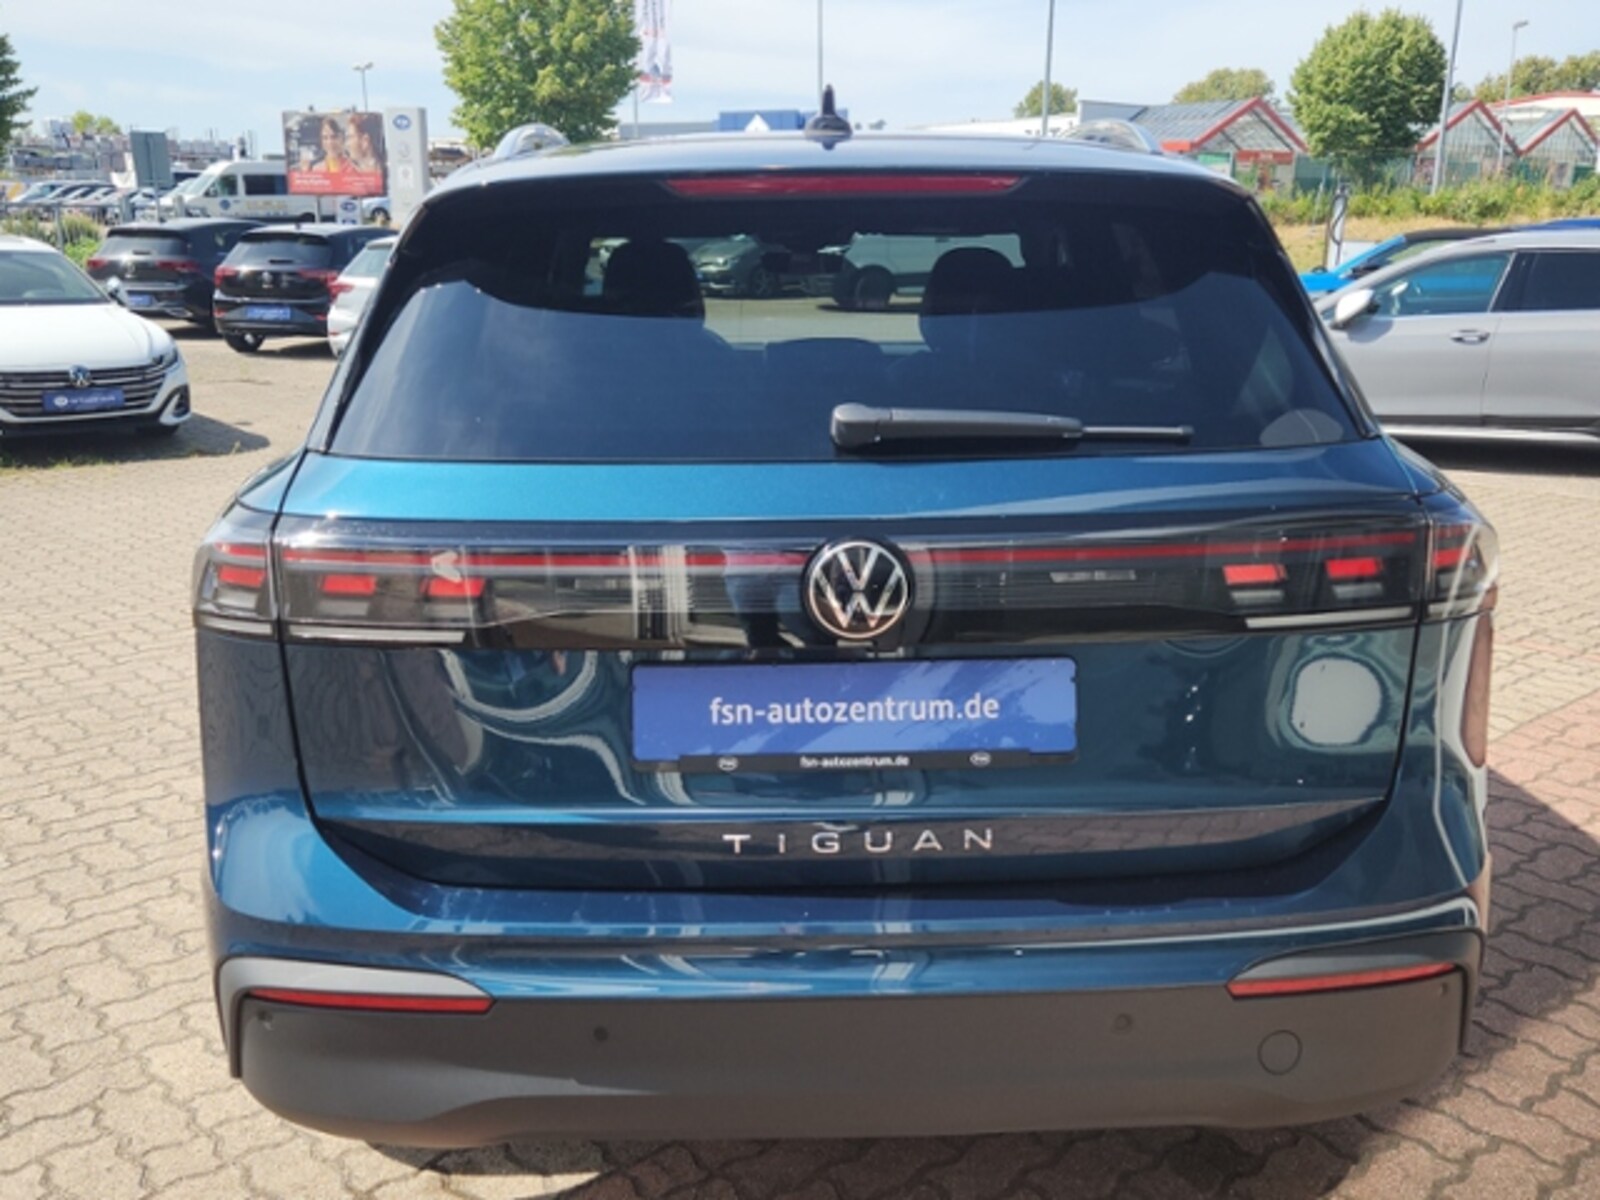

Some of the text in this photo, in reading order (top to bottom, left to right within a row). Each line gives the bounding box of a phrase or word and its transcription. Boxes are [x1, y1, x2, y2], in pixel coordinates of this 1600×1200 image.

[807, 541, 909, 638] VW
[709, 692, 1000, 725] fsn-autozentrum.de
[722, 828, 995, 854] TIGUAN
